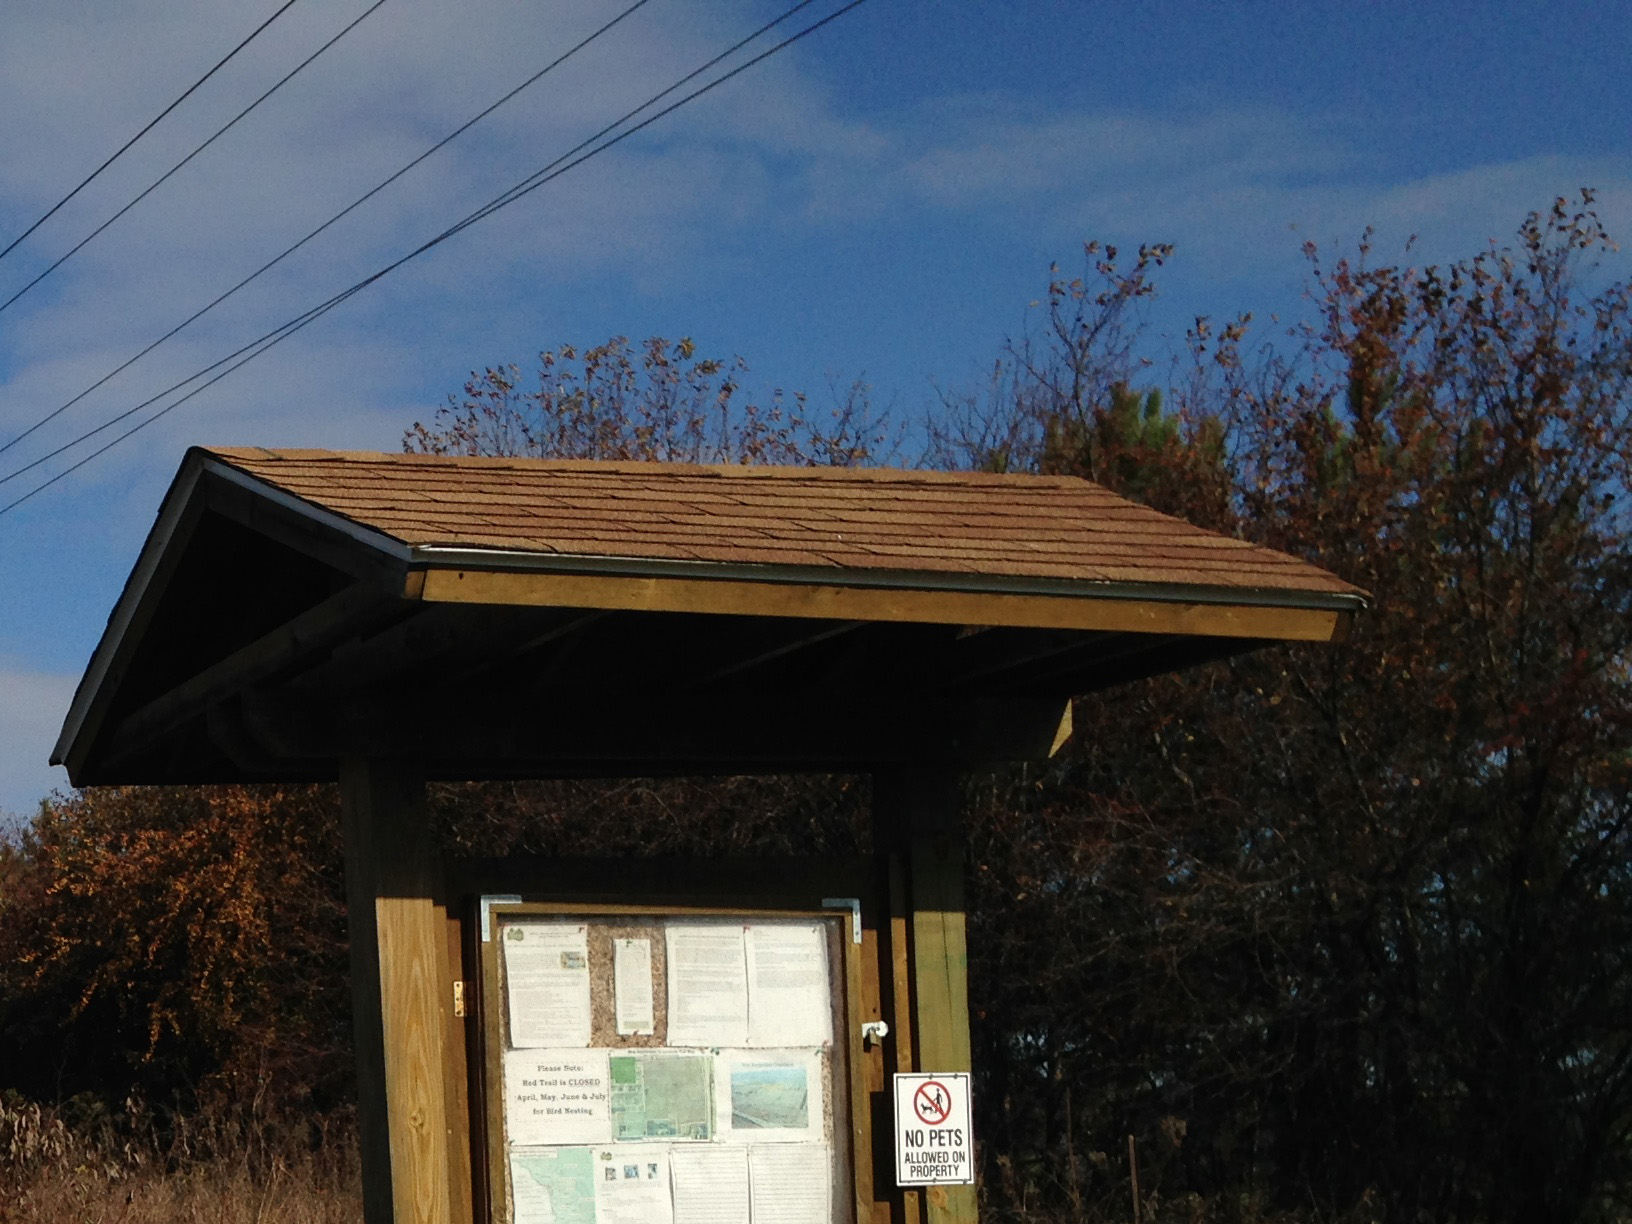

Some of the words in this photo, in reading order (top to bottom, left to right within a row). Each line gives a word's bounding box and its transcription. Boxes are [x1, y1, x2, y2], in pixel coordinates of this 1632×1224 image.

[590, 1093, 606, 1101] July
[905, 1129, 924, 1147] NO
[929, 1129, 962, 1147] PETS
[904, 1151, 949, 1164] ALLOWED
[952, 1151, 965, 1163] ON
[910, 1164, 959, 1177] PROPERTY
